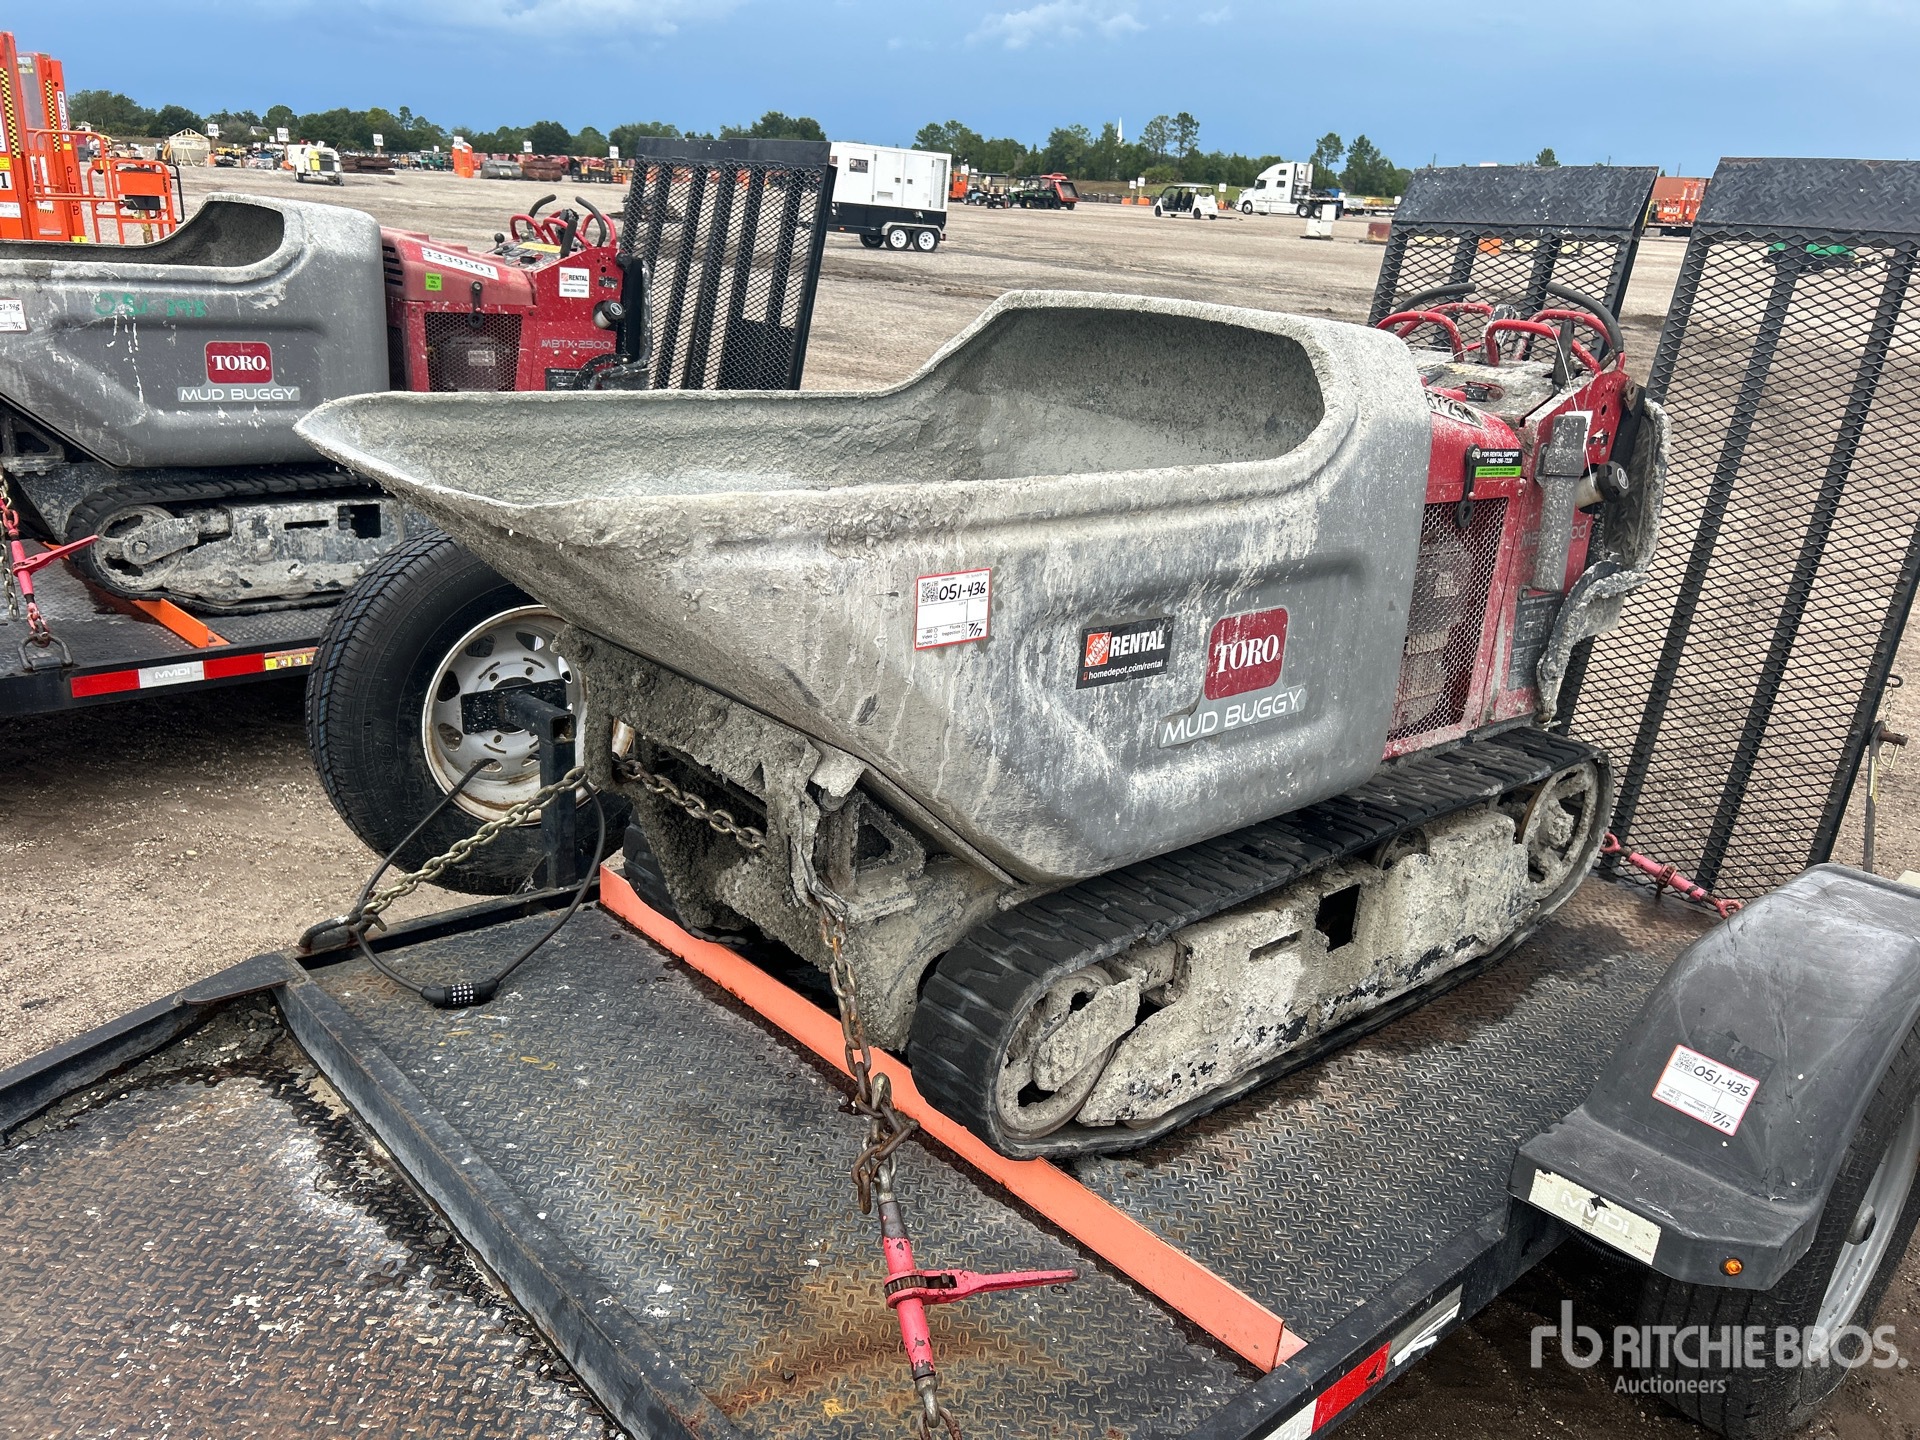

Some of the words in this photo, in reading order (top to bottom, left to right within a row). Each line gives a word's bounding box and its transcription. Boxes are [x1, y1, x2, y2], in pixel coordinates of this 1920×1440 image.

[58, 92, 69, 140] BALLYMOE
[568, 274, 588, 282] RENTAL
[211, 355, 267, 371] TORO
[181, 388, 225, 401] MUD
[231, 388, 295, 400] BUGGY
[939, 581, 986, 601] 051-436
[968, 622, 983, 637] 7/17
[1086, 632, 1111, 667] HOME
[1109, 630, 1165, 657] RENTAL
[1215, 634, 1279, 674] TORO
[154, 667, 191, 680] MMDI
[1088, 659, 1163, 679] homedepot.com/rental
[1162, 711, 1218, 743] MUD
[1225, 689, 1302, 727] BUGGY
[1693, 1065, 1751, 1097] 051-435
[1712, 1111, 1731, 1129] 7/17
